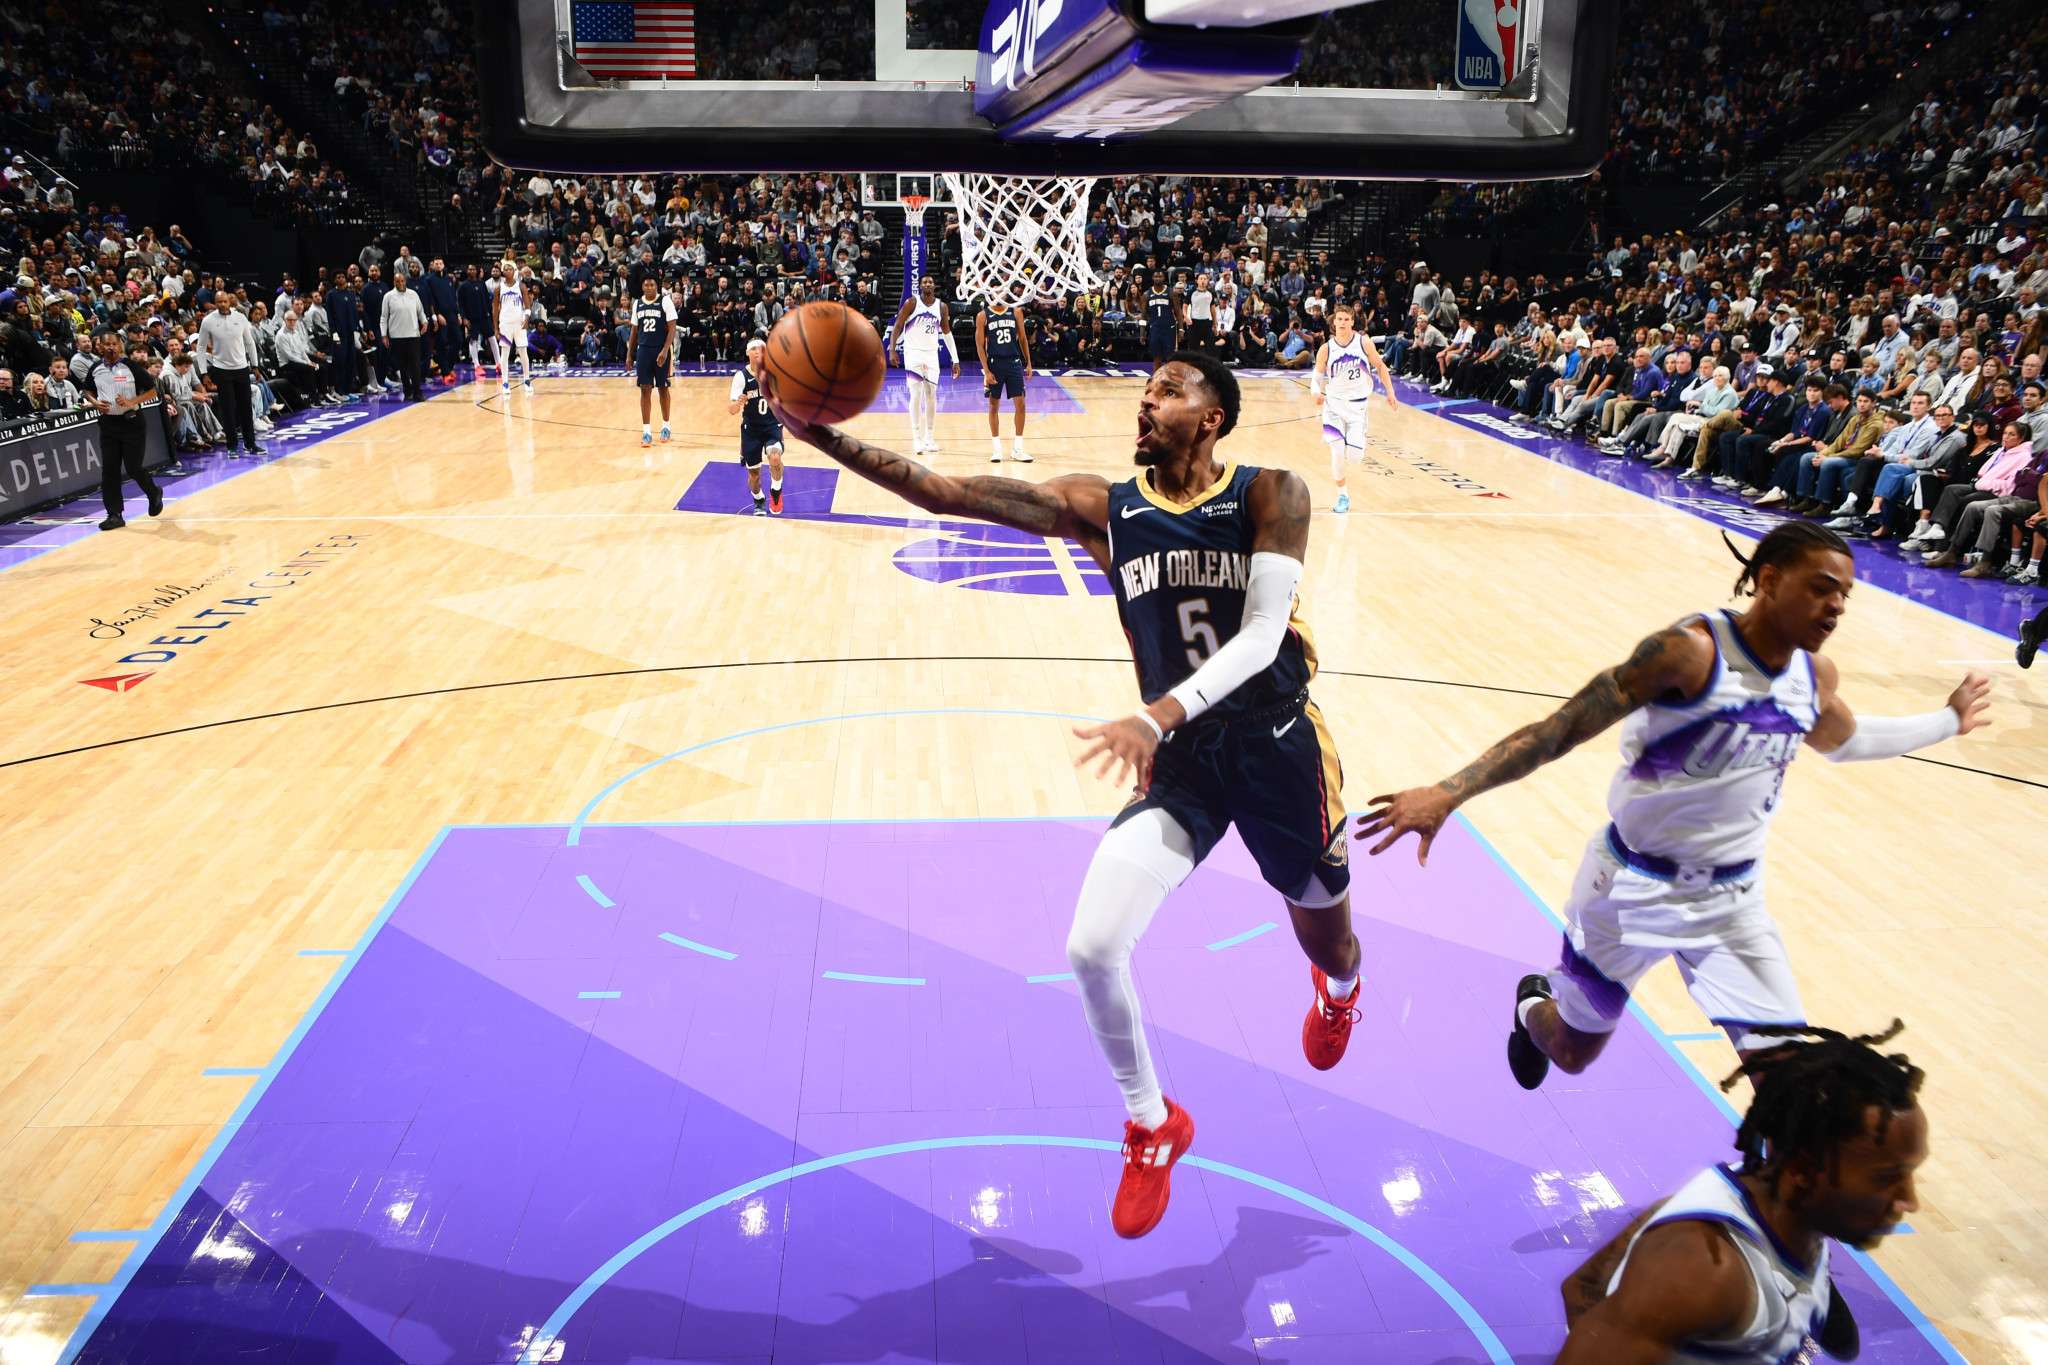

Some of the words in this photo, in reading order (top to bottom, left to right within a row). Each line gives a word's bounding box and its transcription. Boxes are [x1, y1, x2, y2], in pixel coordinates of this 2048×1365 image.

[1465, 56, 1493, 79] NBA
[911, 239, 919, 267] FIRST
[911, 268, 920, 297] ERICA
[643, 318, 656, 332] 22
[925, 325, 936, 335] 20
[996, 328, 1012, 344] 25
[1333, 357, 1361, 377] UTAH
[1348, 368, 1361, 381] 23
[758, 399, 768, 415] 0
[26, 421, 48, 434] DELTA
[60, 414, 79, 426] DELTA
[89, 409, 102, 419] DEL
[10, 439, 102, 493] DELTA
[1201, 501, 1238, 514] NEWAGE
[1119, 551, 1161, 602] NEW
[1166, 550, 1251, 592] ORLEAN
[116, 595, 273, 664] DELTA
[249, 534, 373, 589] CENTER
[1177, 598, 1221, 671] 5
[1683, 721, 1806, 778] UTAH
